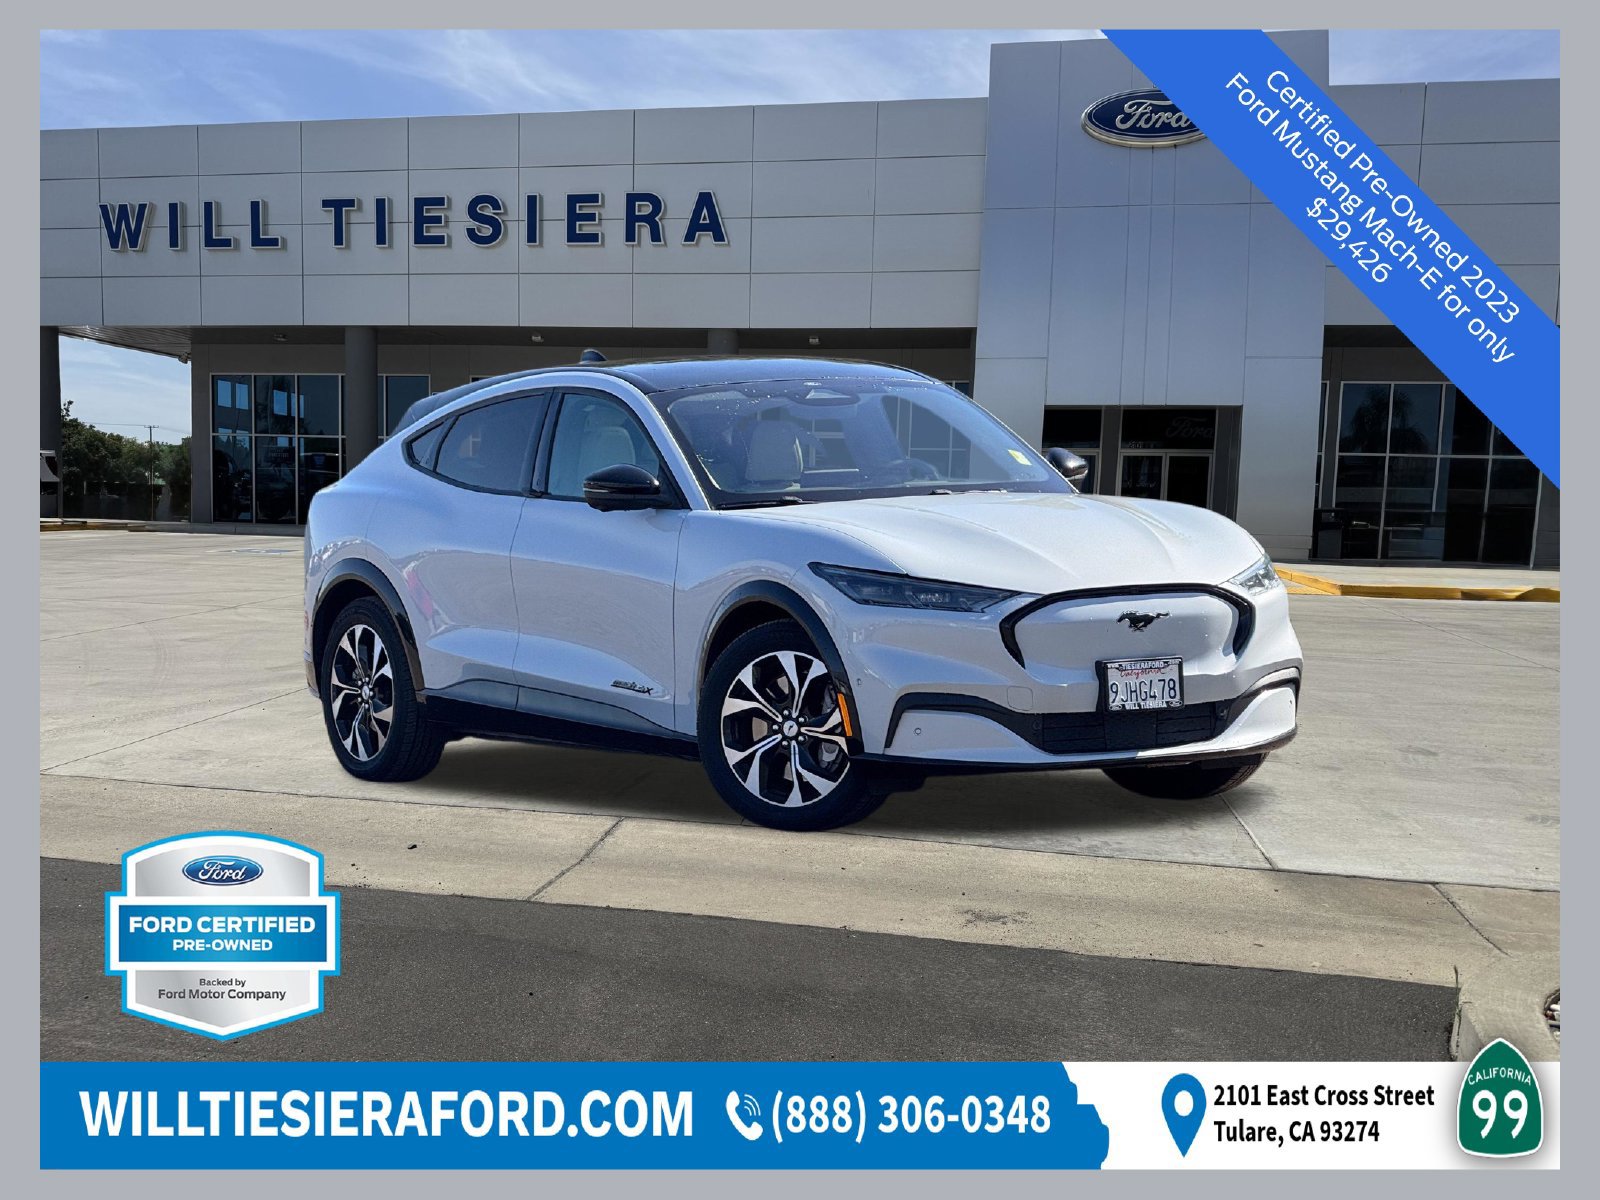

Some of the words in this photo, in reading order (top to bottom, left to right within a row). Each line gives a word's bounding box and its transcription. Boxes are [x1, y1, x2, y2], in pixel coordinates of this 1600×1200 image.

[99, 199, 284, 252] WILL
[321, 190, 729, 248] TIESIERA
[1109, 678, 1177, 704] 9JHG478
